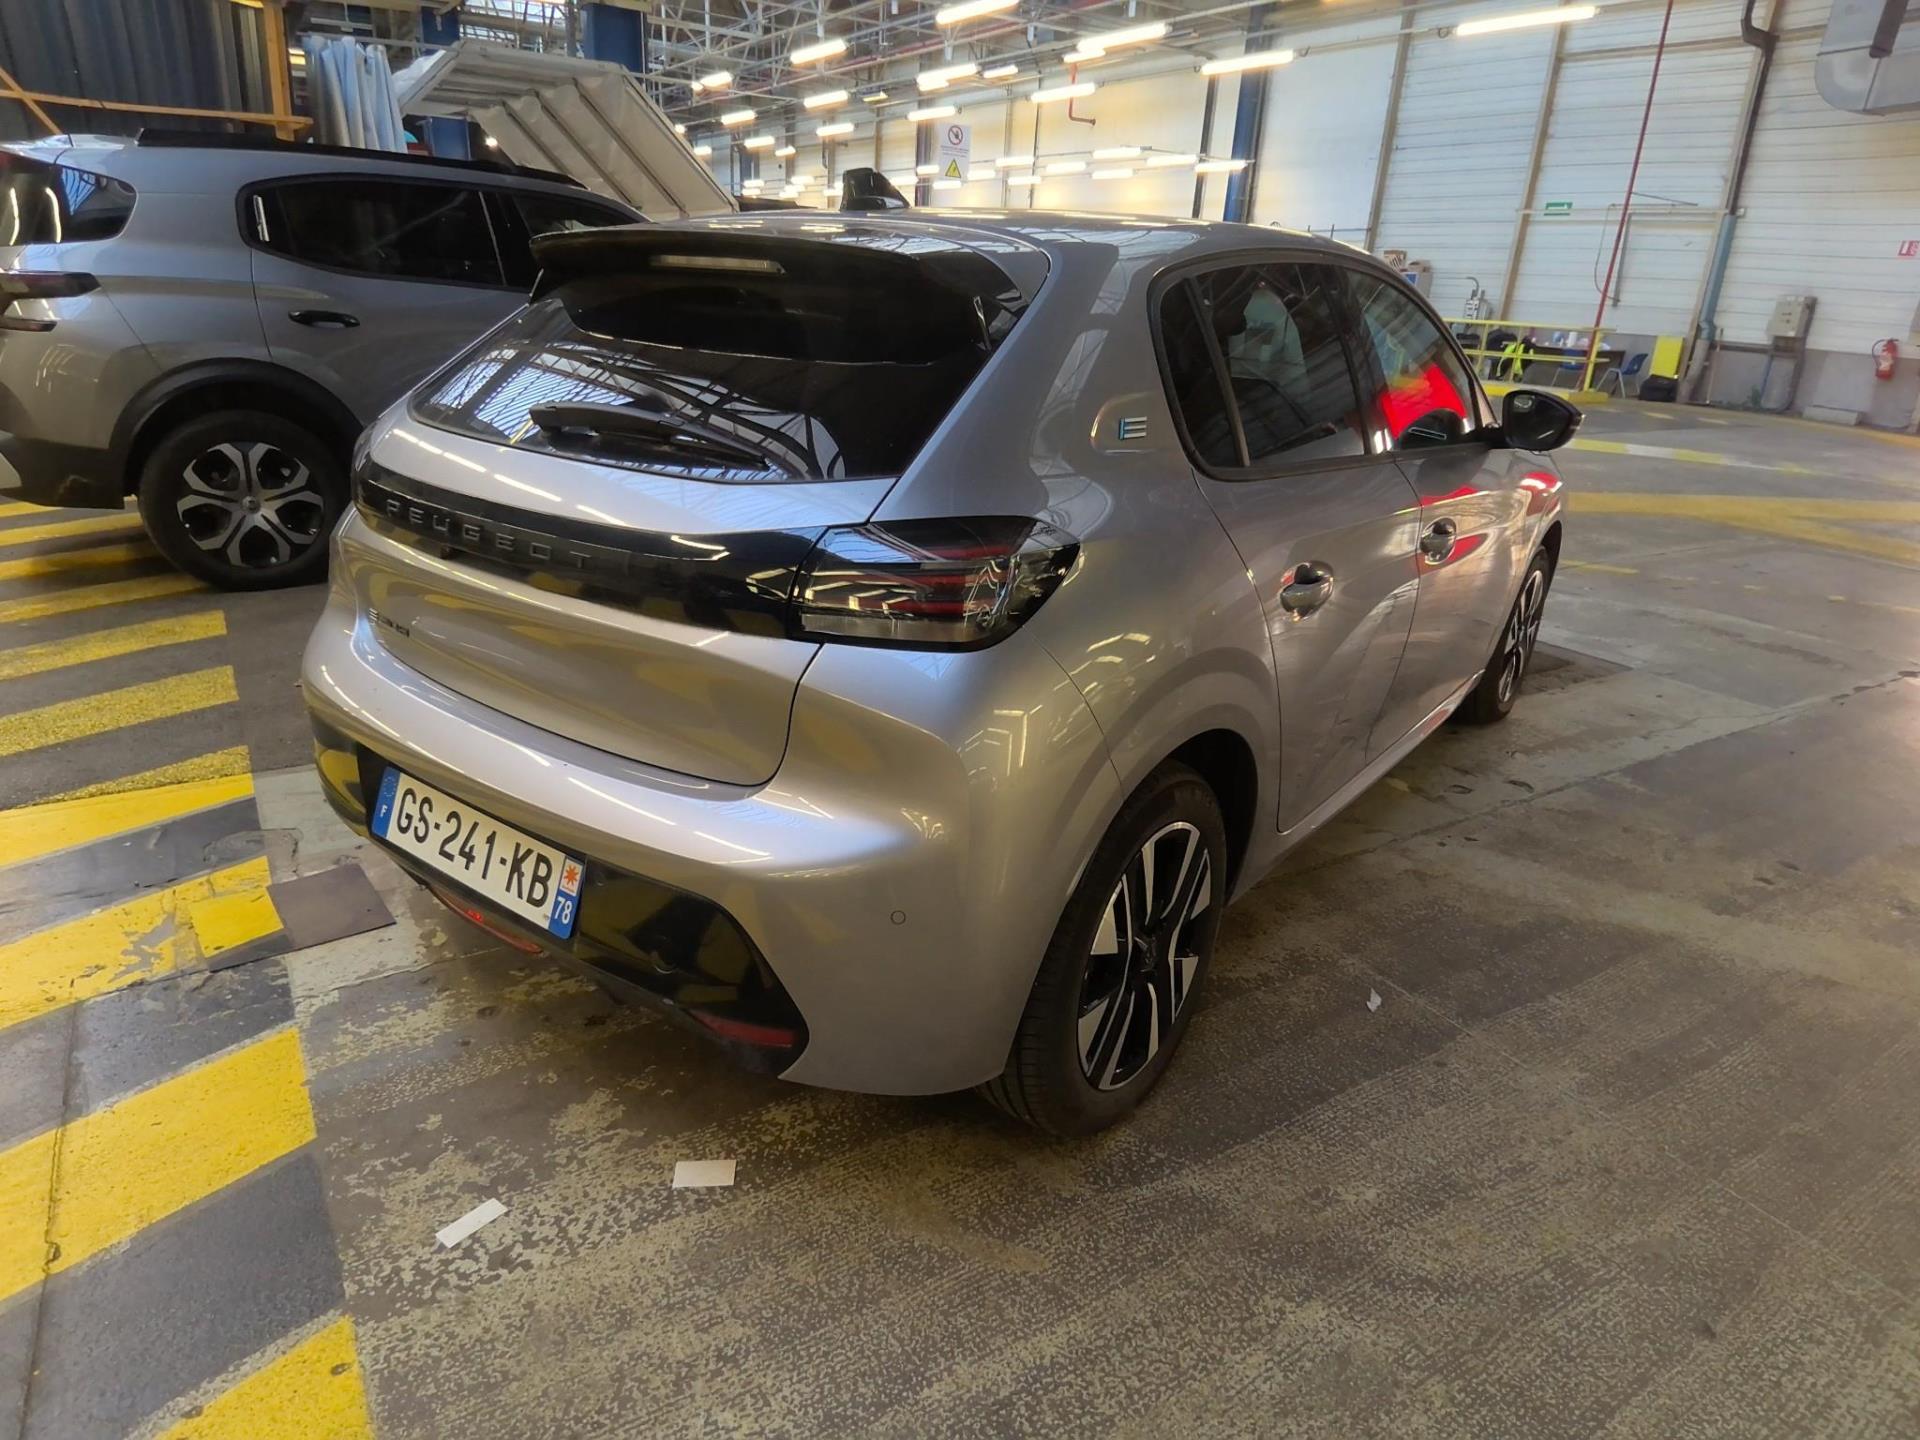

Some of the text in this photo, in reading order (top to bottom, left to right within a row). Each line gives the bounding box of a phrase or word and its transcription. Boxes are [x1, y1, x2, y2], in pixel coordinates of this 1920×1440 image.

[386, 499, 592, 570] PEUGEOT
[379, 804, 388, 818] F
[396, 787, 553, 908] GS-241-KB
[553, 895, 573, 925] 78
